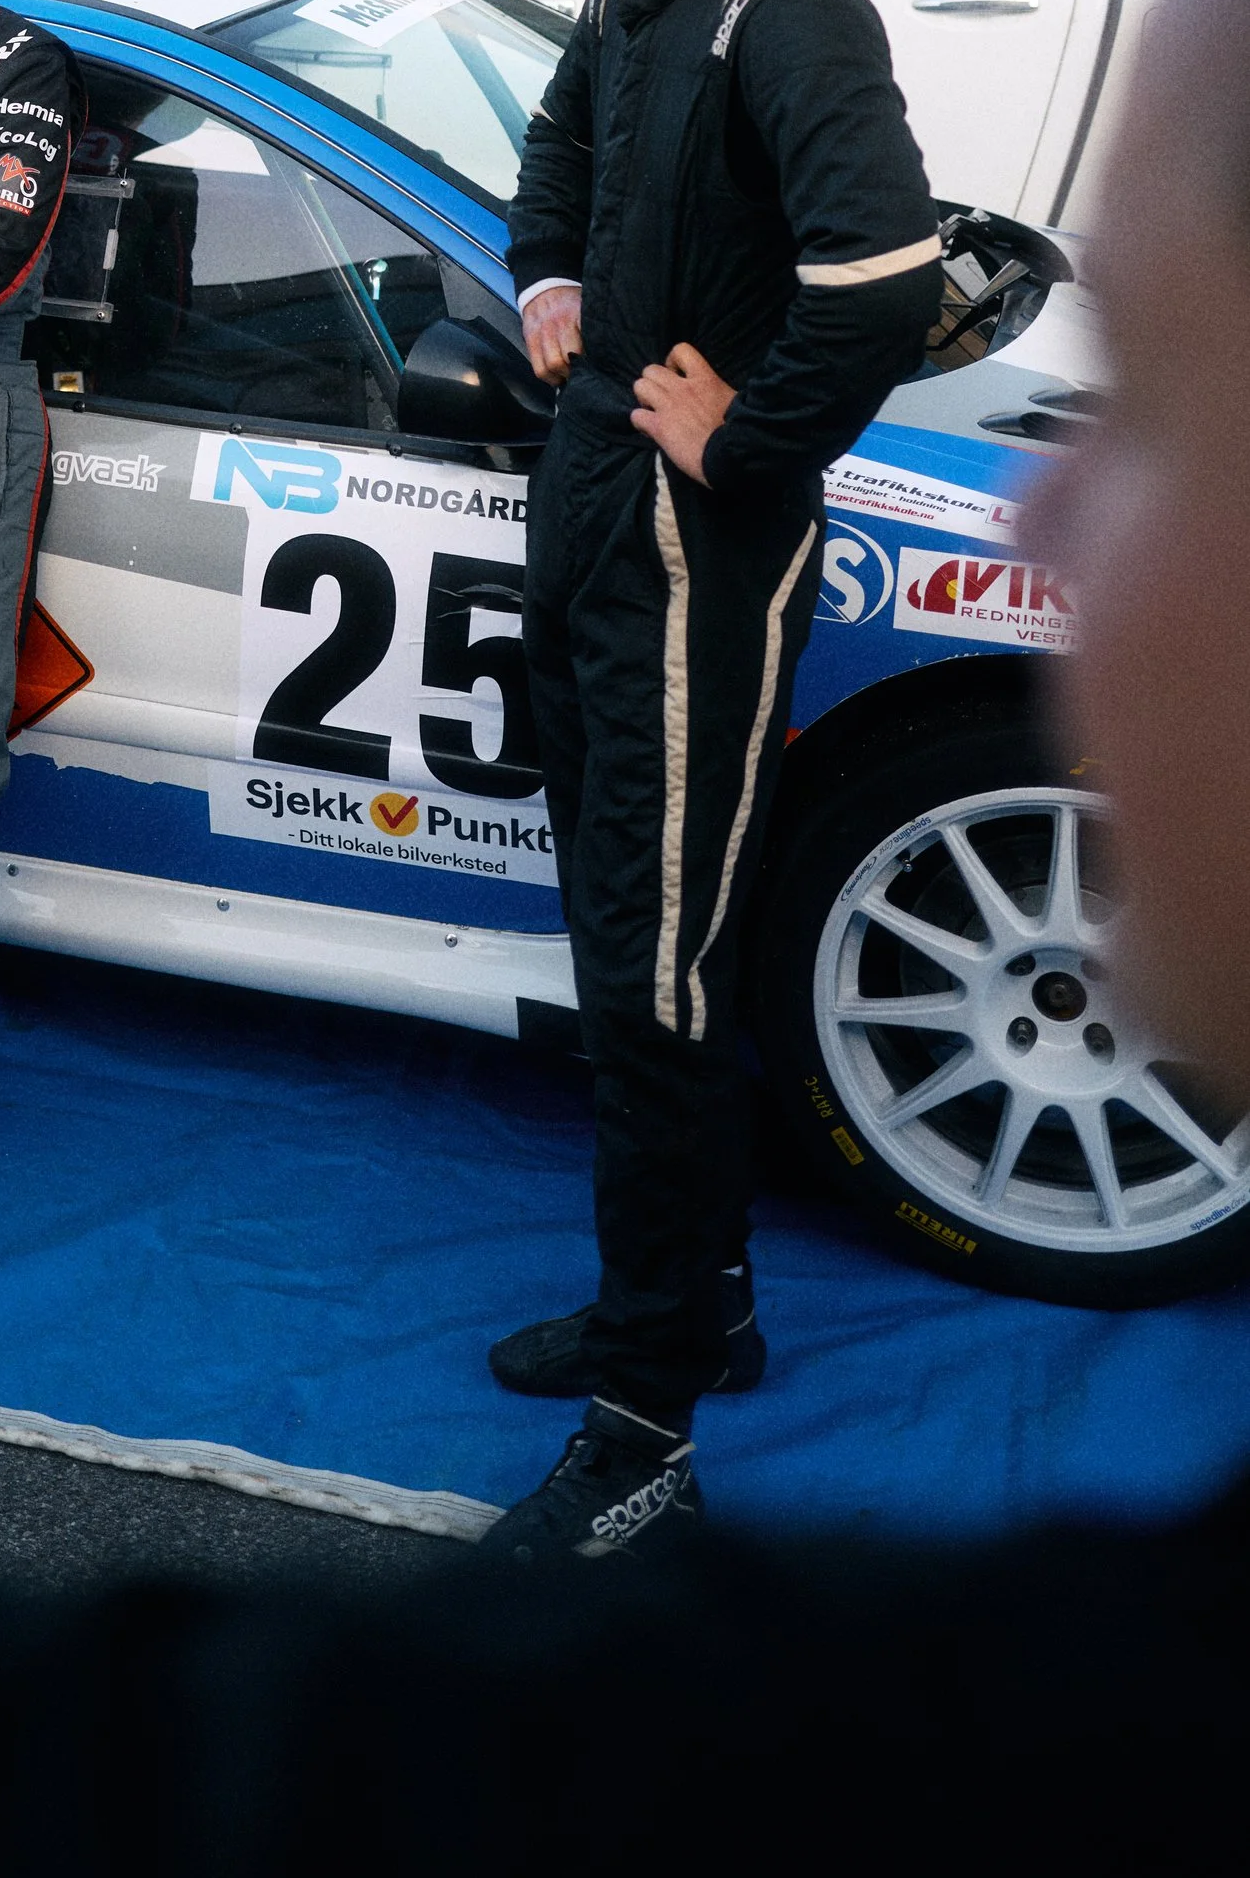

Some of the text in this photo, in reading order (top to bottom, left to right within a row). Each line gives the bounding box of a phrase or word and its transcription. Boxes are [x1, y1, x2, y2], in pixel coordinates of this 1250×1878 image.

[51, 450, 168, 493] gvask
[841, 470, 987, 514] trafikkskole
[836, 481, 888, 499] ferdighet
[899, 495, 948, 513] holdning
[252, 533, 546, 800] 25
[245, 778, 553, 854] Sjekk Punkt
[894, 816, 932, 843] speedline
[298, 827, 335, 849] Ditt
[337, 833, 394, 859] lokale
[396, 842, 508, 875] bilverksted
[898, 1200, 978, 1256] PIRELLI
[1189, 1205, 1231, 1231] speedline
[591, 1468, 677, 1542] sparco
